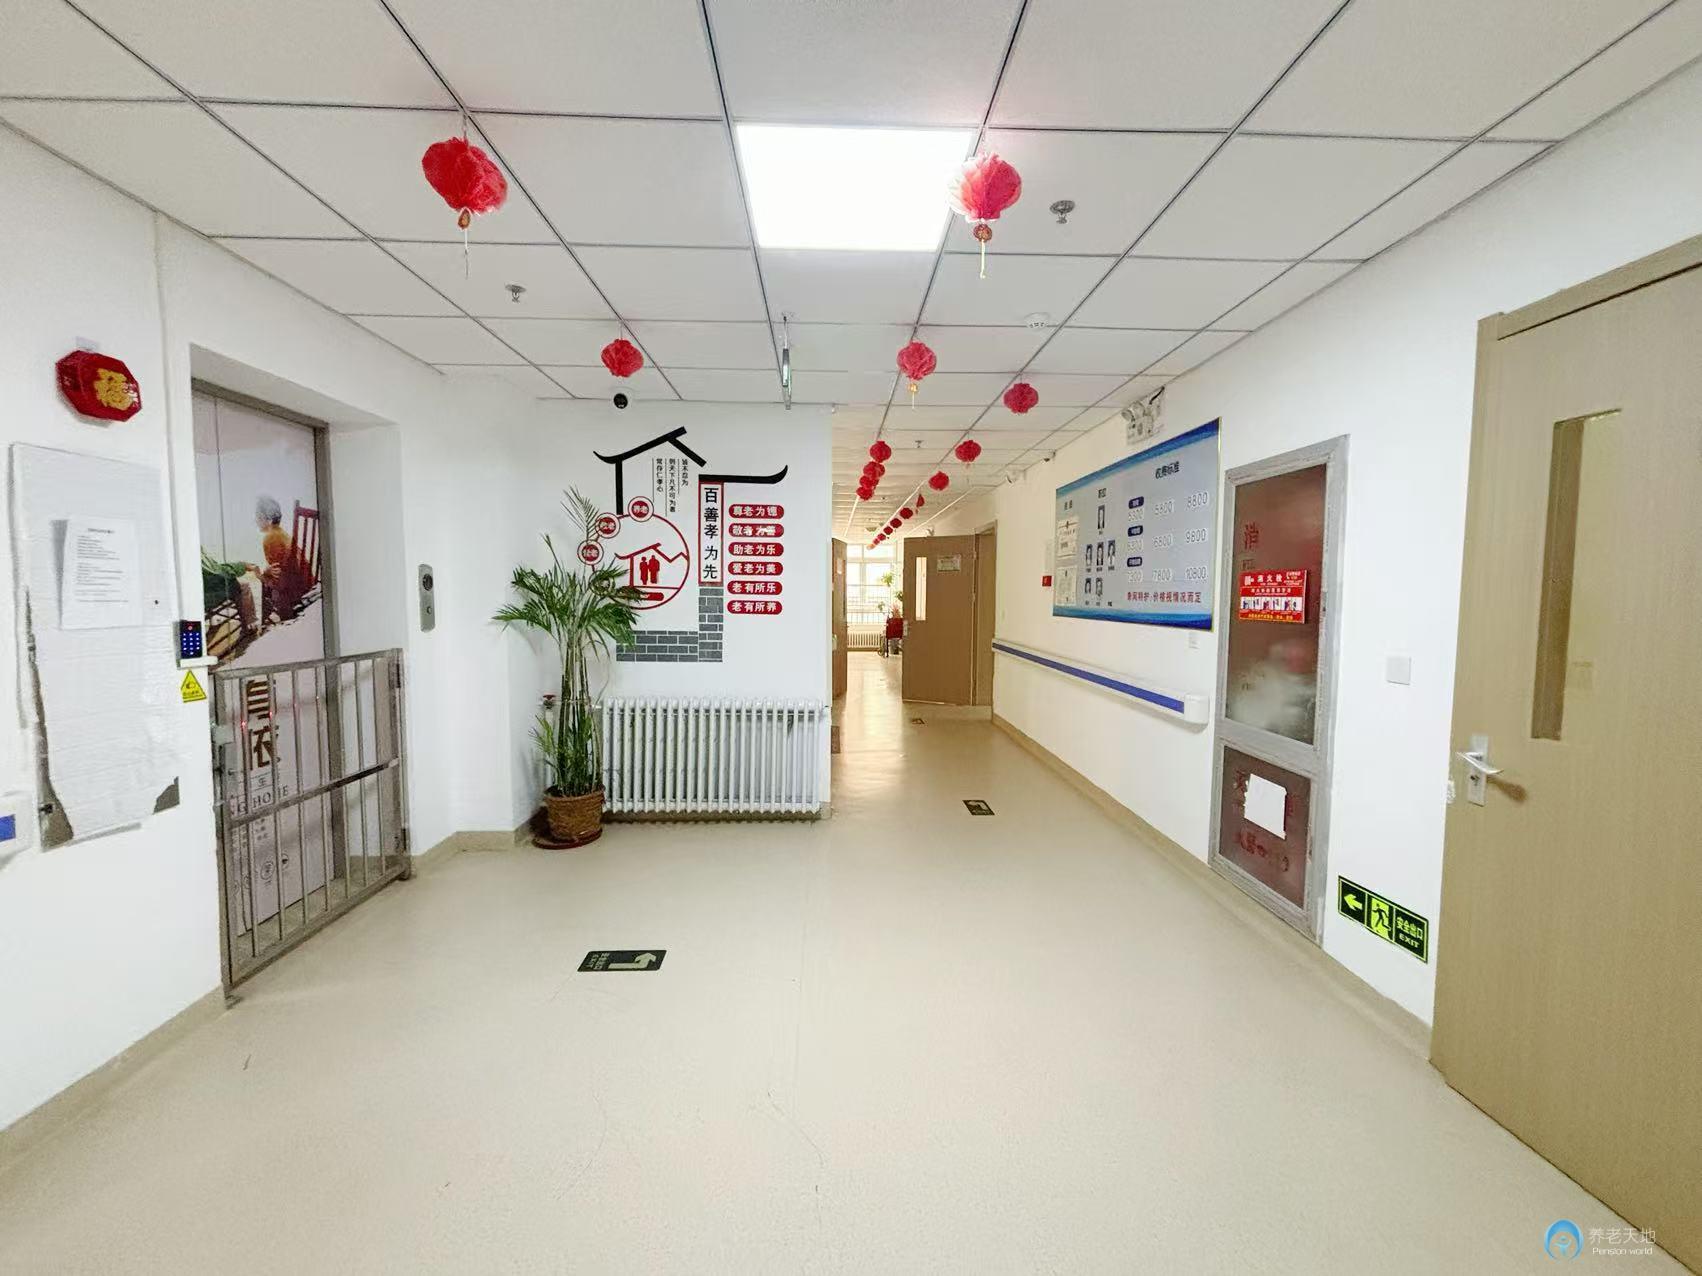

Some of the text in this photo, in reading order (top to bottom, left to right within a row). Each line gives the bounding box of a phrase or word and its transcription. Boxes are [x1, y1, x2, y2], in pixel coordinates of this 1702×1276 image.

[703, 487, 719, 579] 百善孝为先
[1185, 528, 1206, 543] 9800
[733, 544, 776, 555] 助老为乐
[732, 582, 776, 593] 老有所乐
[732, 601, 777, 612] 老有所养
[1397, 916, 1423, 940] 安全出口
[1399, 933, 1420, 948] EXIT
